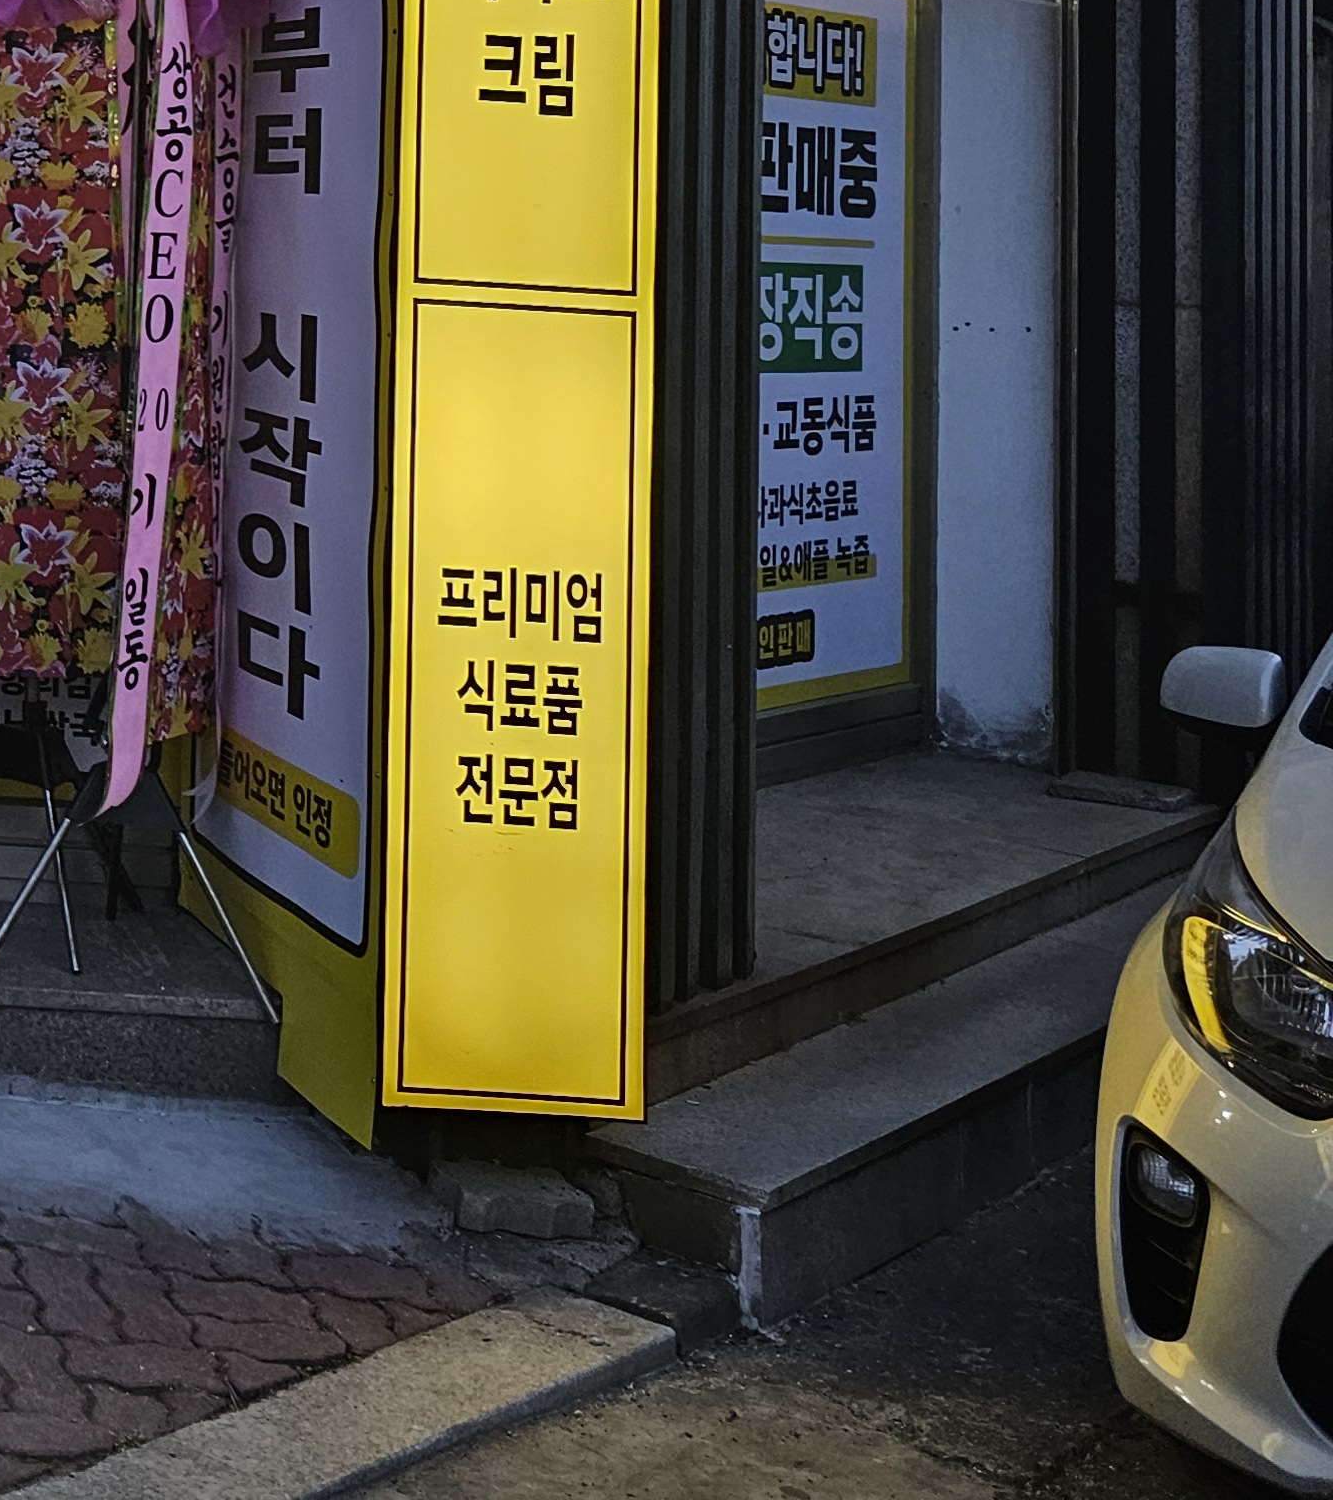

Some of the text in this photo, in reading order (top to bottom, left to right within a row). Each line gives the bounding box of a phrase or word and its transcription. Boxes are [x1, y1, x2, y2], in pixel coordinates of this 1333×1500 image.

[478, 32, 577, 118] 크림
[144, 40, 193, 345] 상공CEO
[235, 311, 323, 721] 시작이다
[834, 534, 870, 576] 녹즙
[116, 567, 148, 692] 일동
[437, 566, 605, 645] 프리미엄
[457, 657, 585, 738] 식료품
[292, 783, 333, 849] 인정
[455, 752, 580, 832] 전문점
